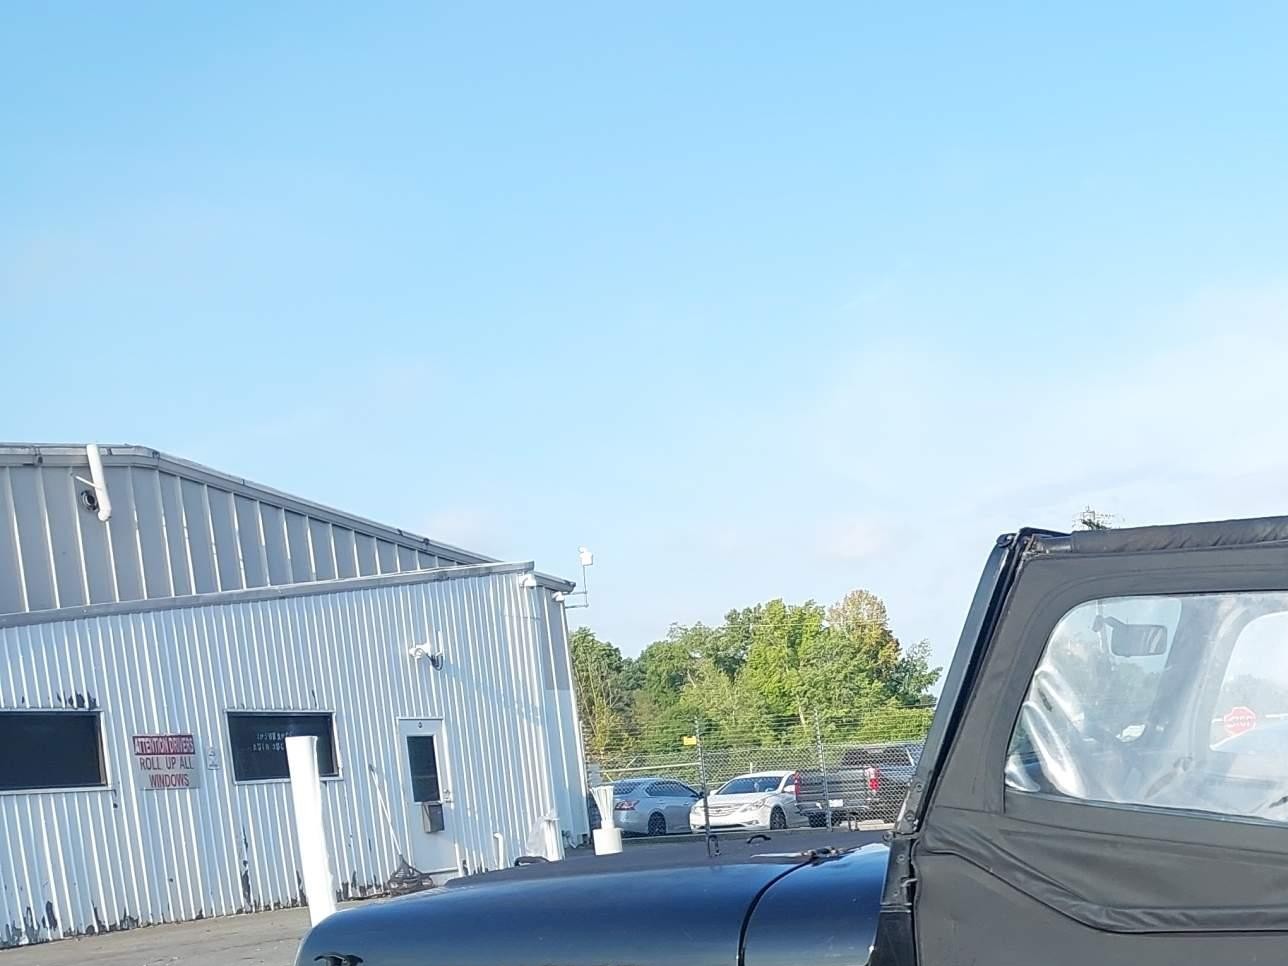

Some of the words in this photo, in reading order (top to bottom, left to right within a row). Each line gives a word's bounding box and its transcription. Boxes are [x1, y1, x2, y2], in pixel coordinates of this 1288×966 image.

[134, 737, 168, 752] ATTENTION
[168, 736, 194, 752] DRIVERS
[139, 757, 161, 770] ROLL
[165, 756, 176, 770] UP
[180, 756, 194, 769] ALL
[149, 774, 189, 787] WINDOWS
